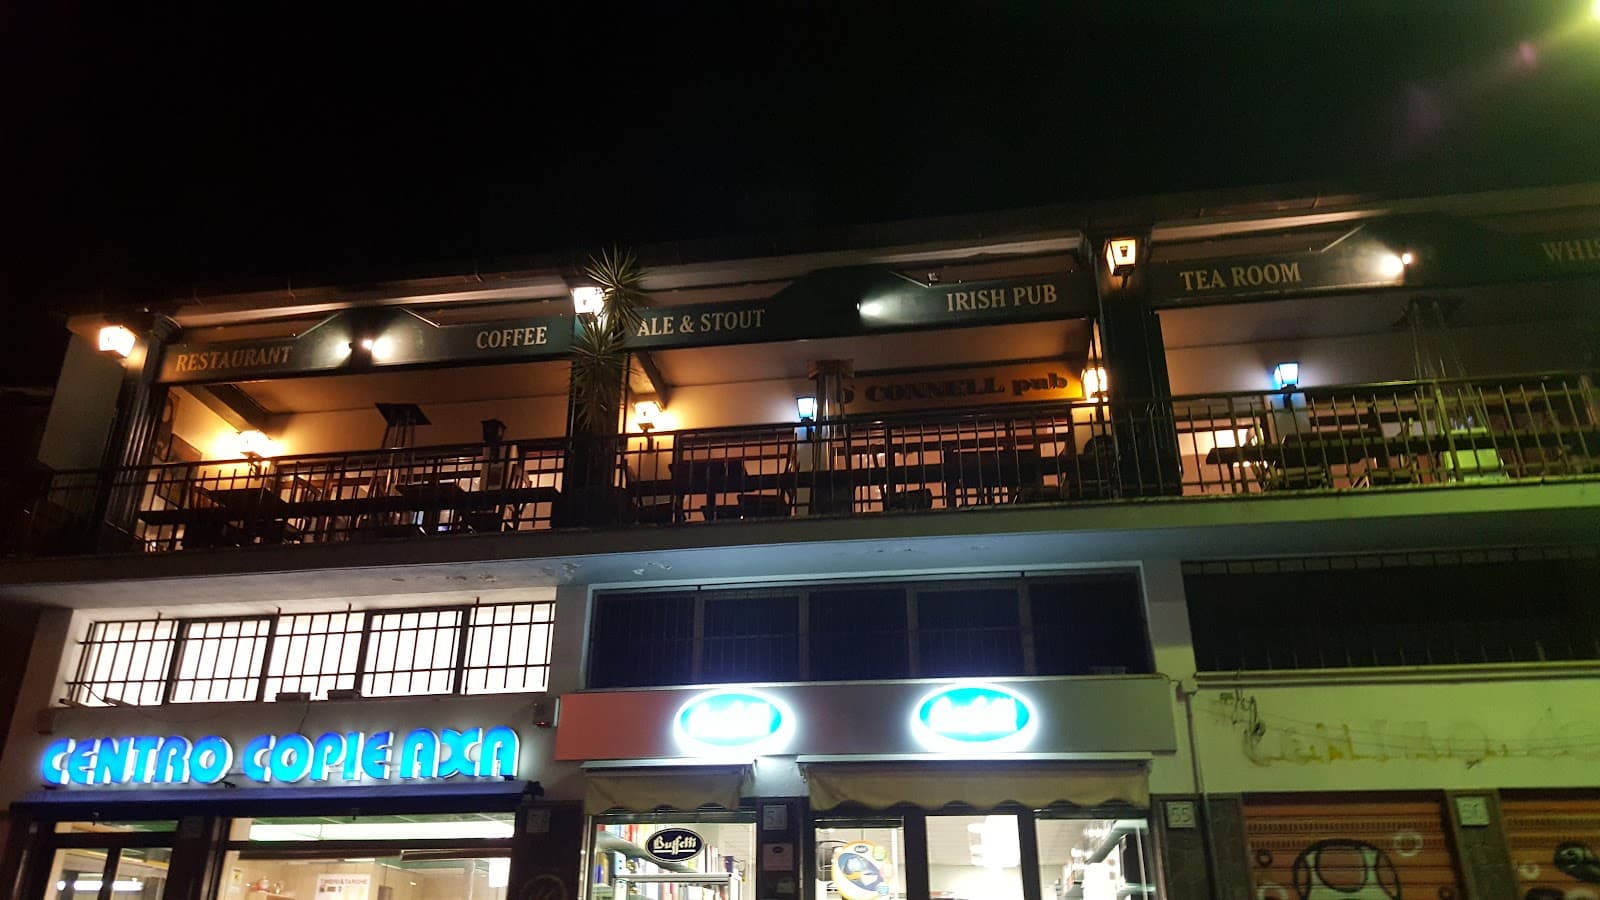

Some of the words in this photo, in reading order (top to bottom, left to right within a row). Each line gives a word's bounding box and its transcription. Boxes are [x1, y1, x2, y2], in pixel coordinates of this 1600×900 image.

[1180, 269, 1225, 292] TEA
[1232, 262, 1302, 287] ROOM
[946, 289, 1008, 313] IRISH
[1013, 284, 1058, 306] PUB
[637, 315, 675, 337] ALE
[680, 315, 697, 334] &
[700, 309, 766, 333] STOUT
[476, 326, 548, 350] COFFEE
[175, 346, 293, 373] RESTAURANT
[865, 377, 1005, 402] CONNELL
[1012, 373, 1068, 396] pub
[41, 735, 233, 786] CENTRO
[242, 730, 393, 783] COPIE
[400, 726, 521, 779] AXA
[653, 835, 697, 855] Buffetti
